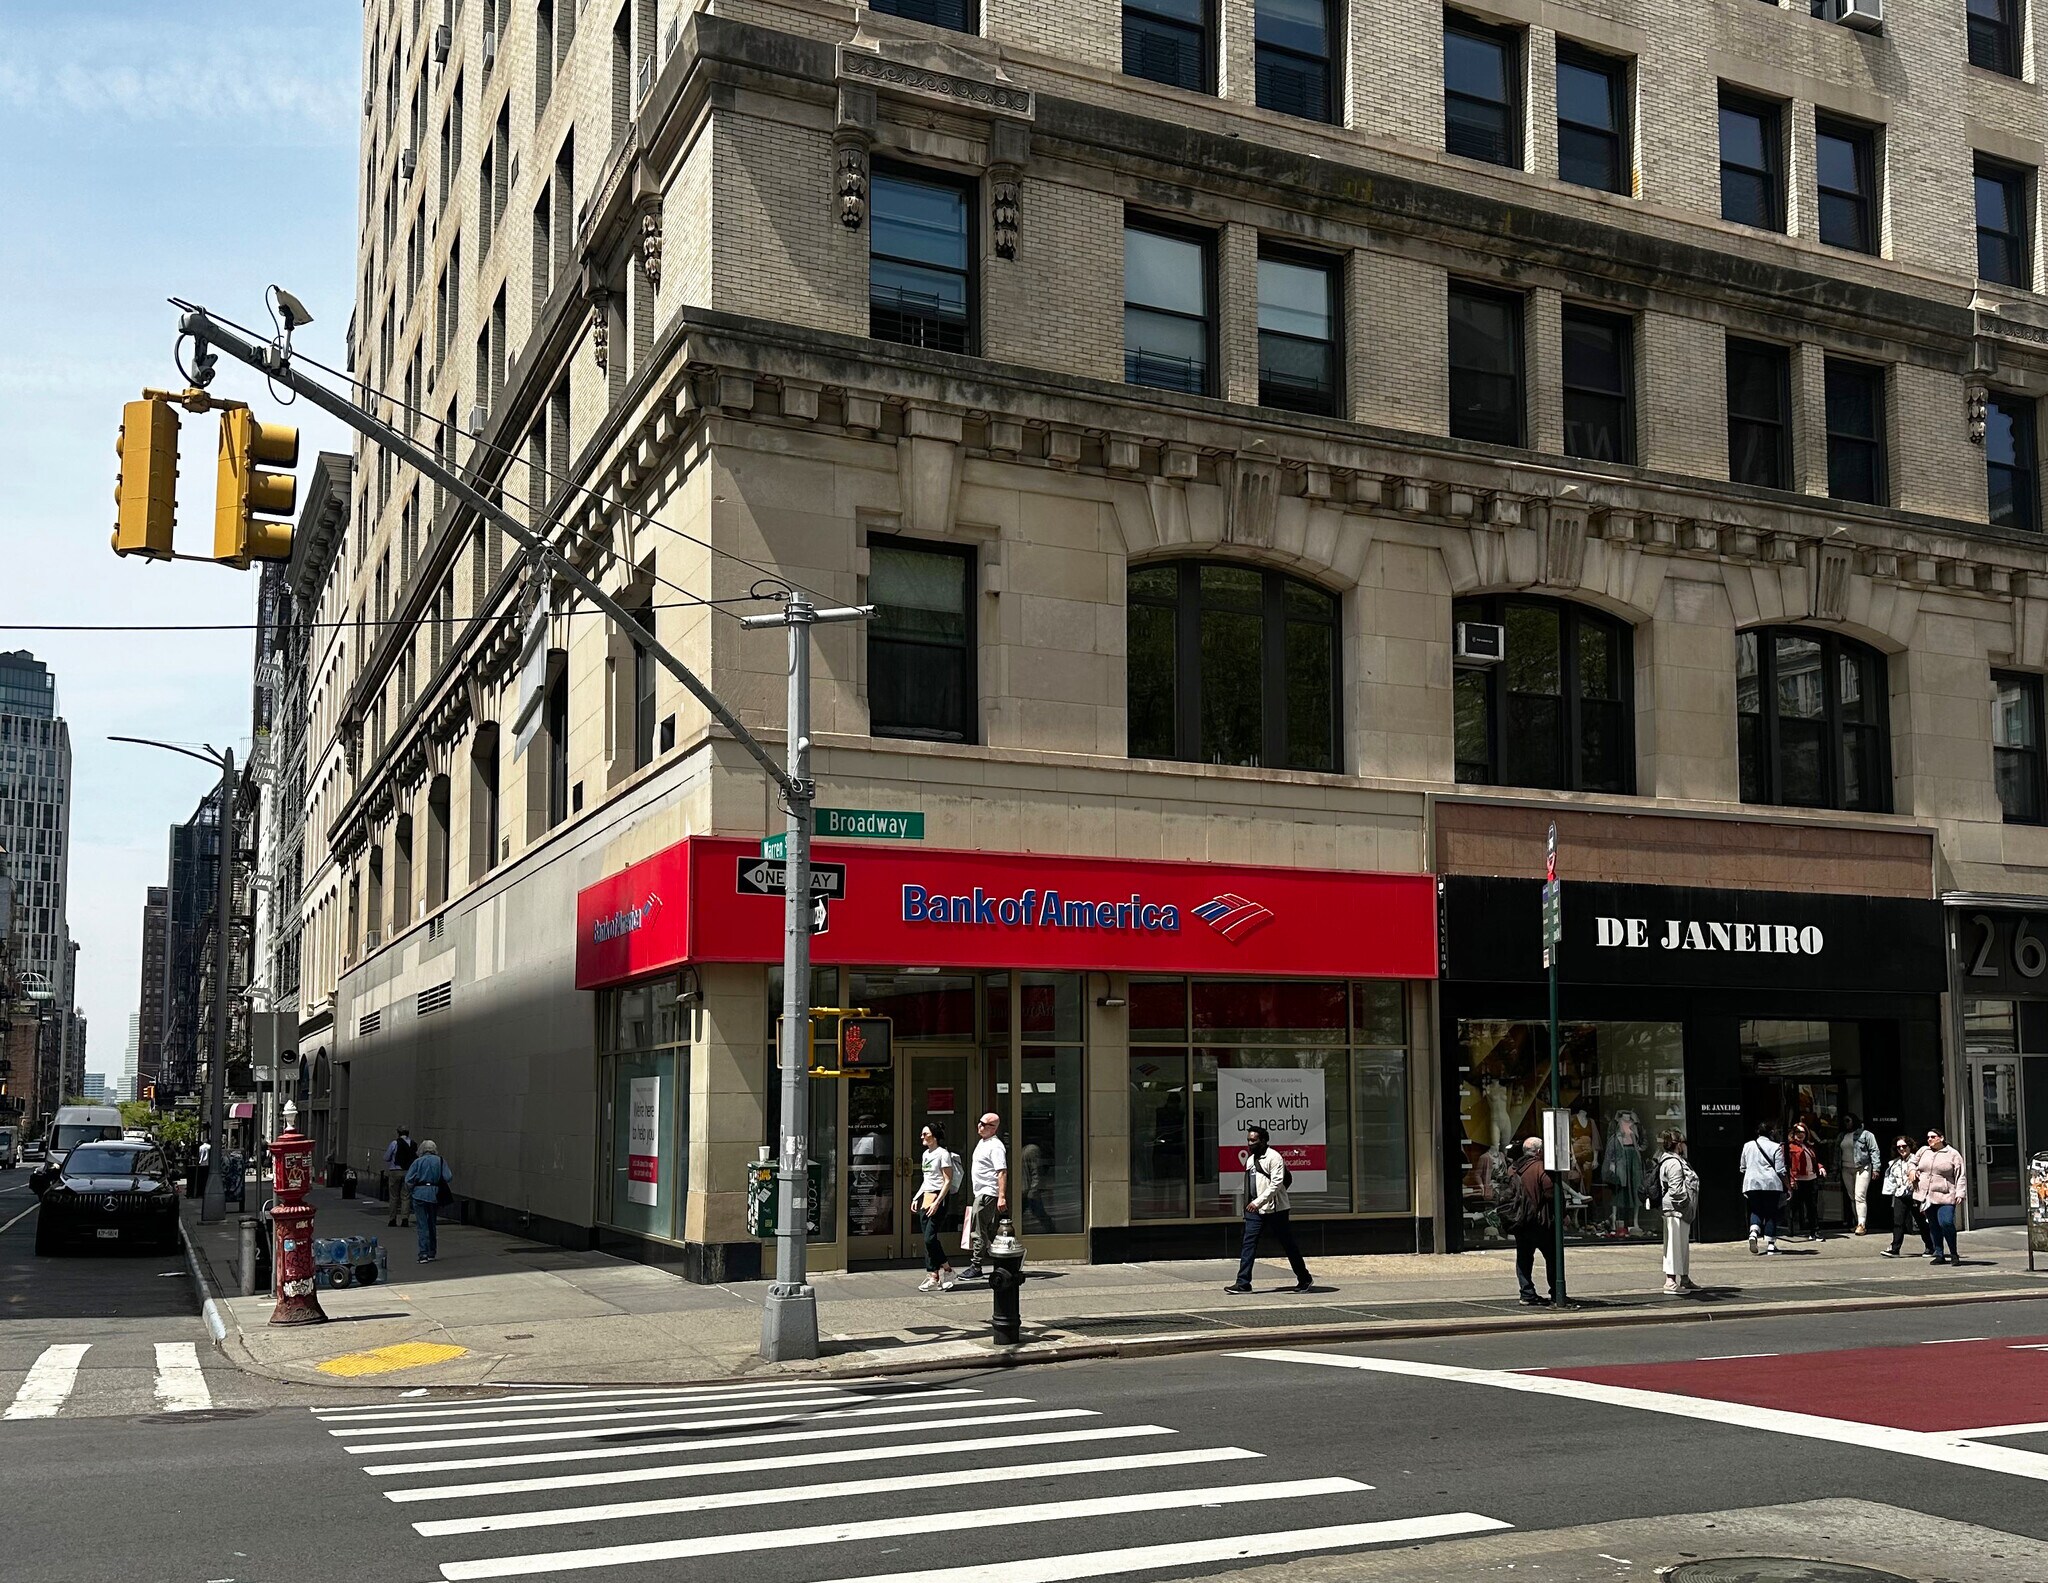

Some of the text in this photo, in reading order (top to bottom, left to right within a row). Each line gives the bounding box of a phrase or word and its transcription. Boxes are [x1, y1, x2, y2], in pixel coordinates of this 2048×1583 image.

[829, 811, 908, 838] Broadway
[763, 840, 783, 859] Warren
[754, 869, 832, 888] ONE AY
[902, 884, 1181, 931] Bank of America
[1595, 917, 1824, 955] DE JANEIRO
[1235, 1092, 1309, 1109] Bank with
[1237, 1115, 1309, 1136] us nearby
